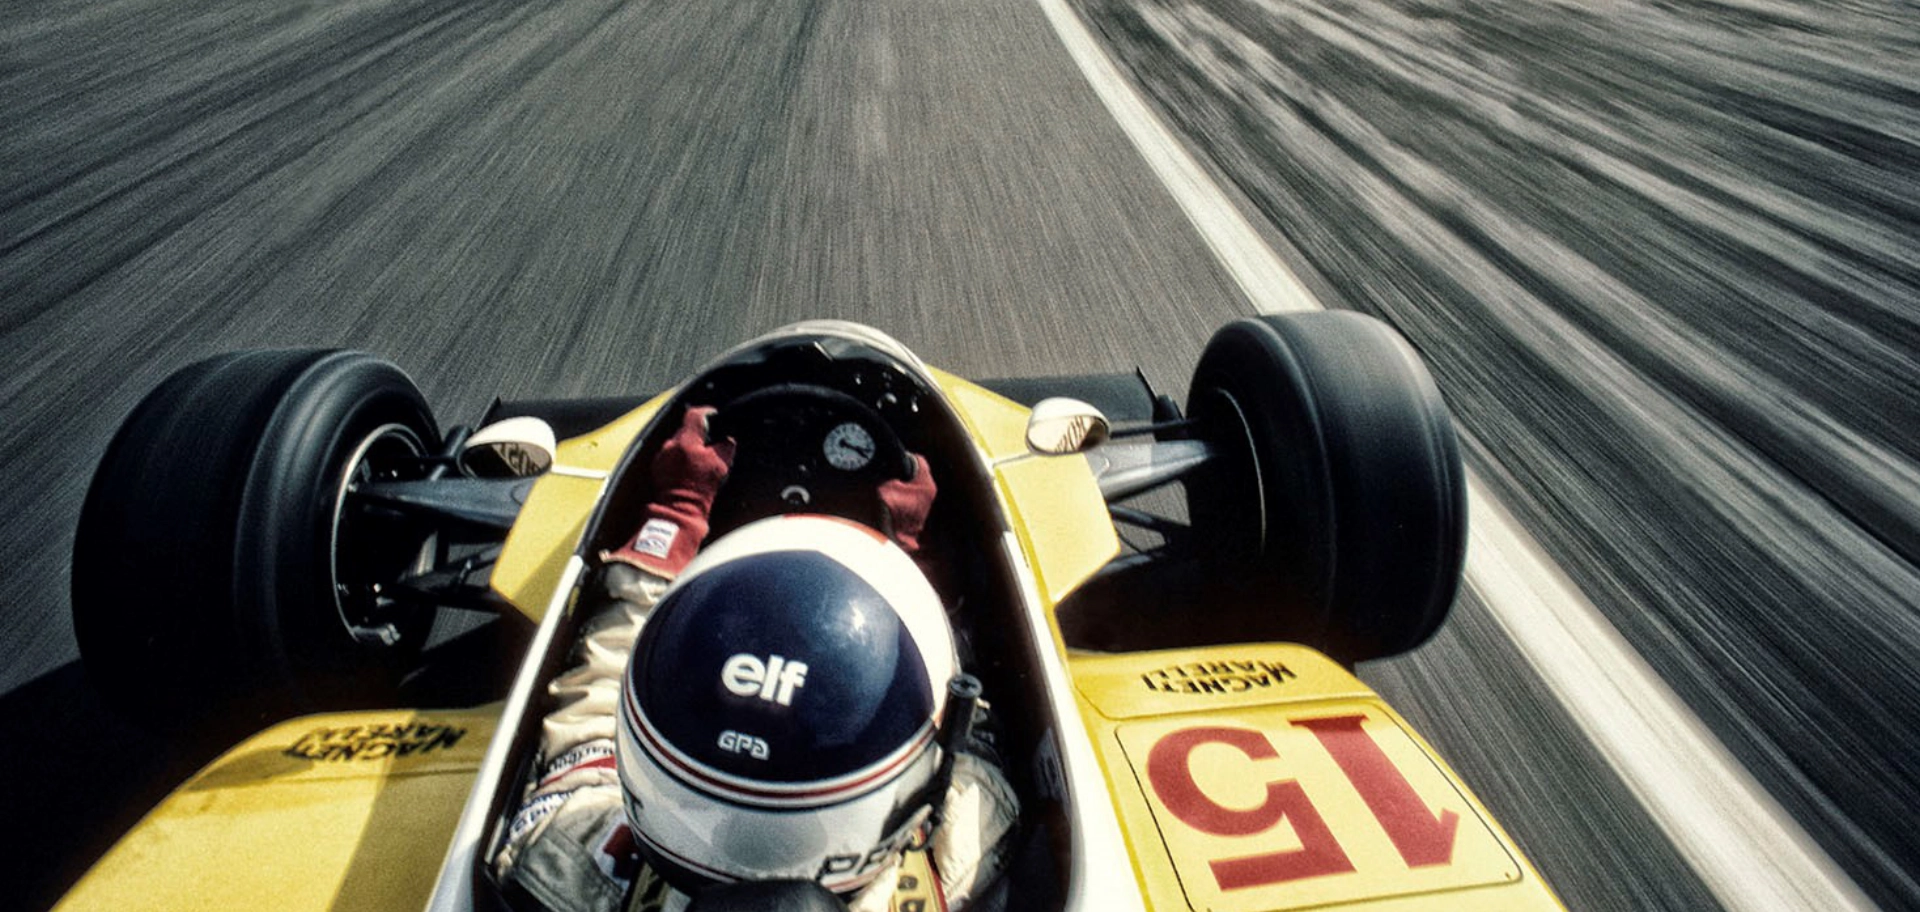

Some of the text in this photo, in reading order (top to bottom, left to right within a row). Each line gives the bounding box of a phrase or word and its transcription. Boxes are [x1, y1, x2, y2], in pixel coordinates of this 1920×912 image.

[721, 652, 809, 707] elf
[1140, 663, 1297, 695] MAGNETI
[716, 729, 770, 761] GPA
[1145, 711, 1460, 892] 15
